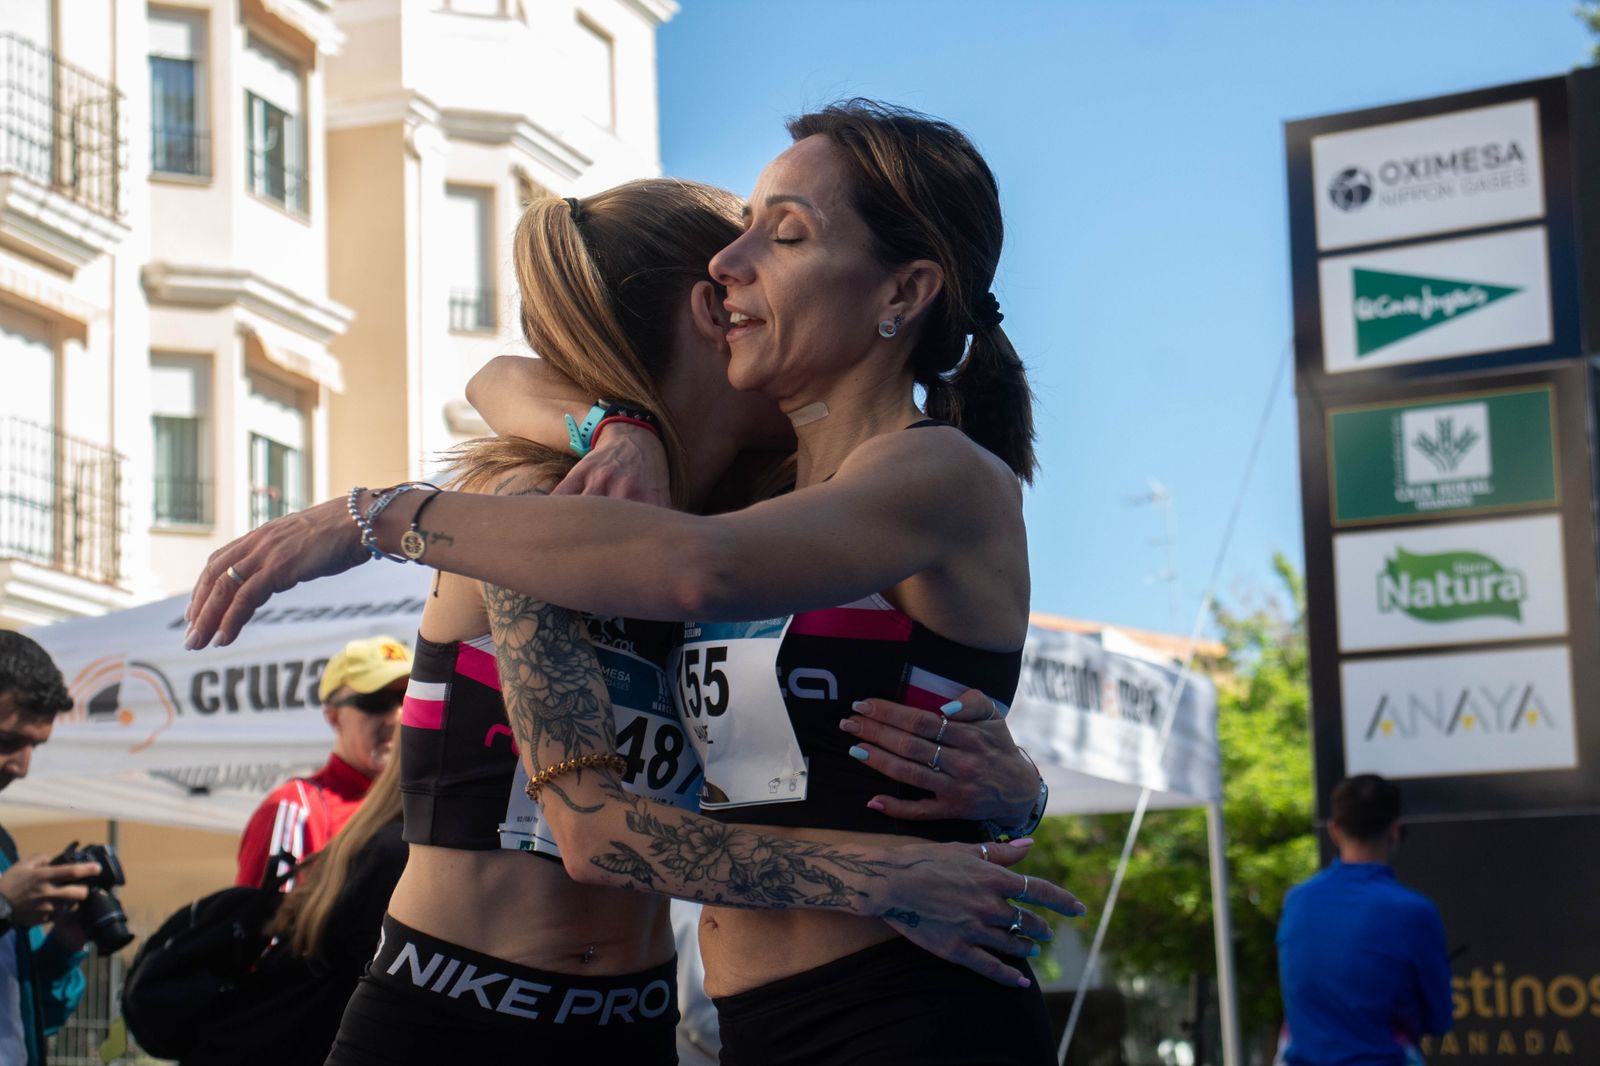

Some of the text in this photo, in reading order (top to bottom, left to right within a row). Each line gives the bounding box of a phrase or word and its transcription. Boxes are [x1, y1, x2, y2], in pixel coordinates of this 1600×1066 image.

[1378, 141, 1526, 186] OXIMESA
[1380, 571, 1525, 612] Natura
[191, 657, 328, 715] cruza
[601, 664, 631, 683] MESA
[1366, 684, 1556, 741] ANAYA
[387, 942, 670, 1025] NIKE PRO
